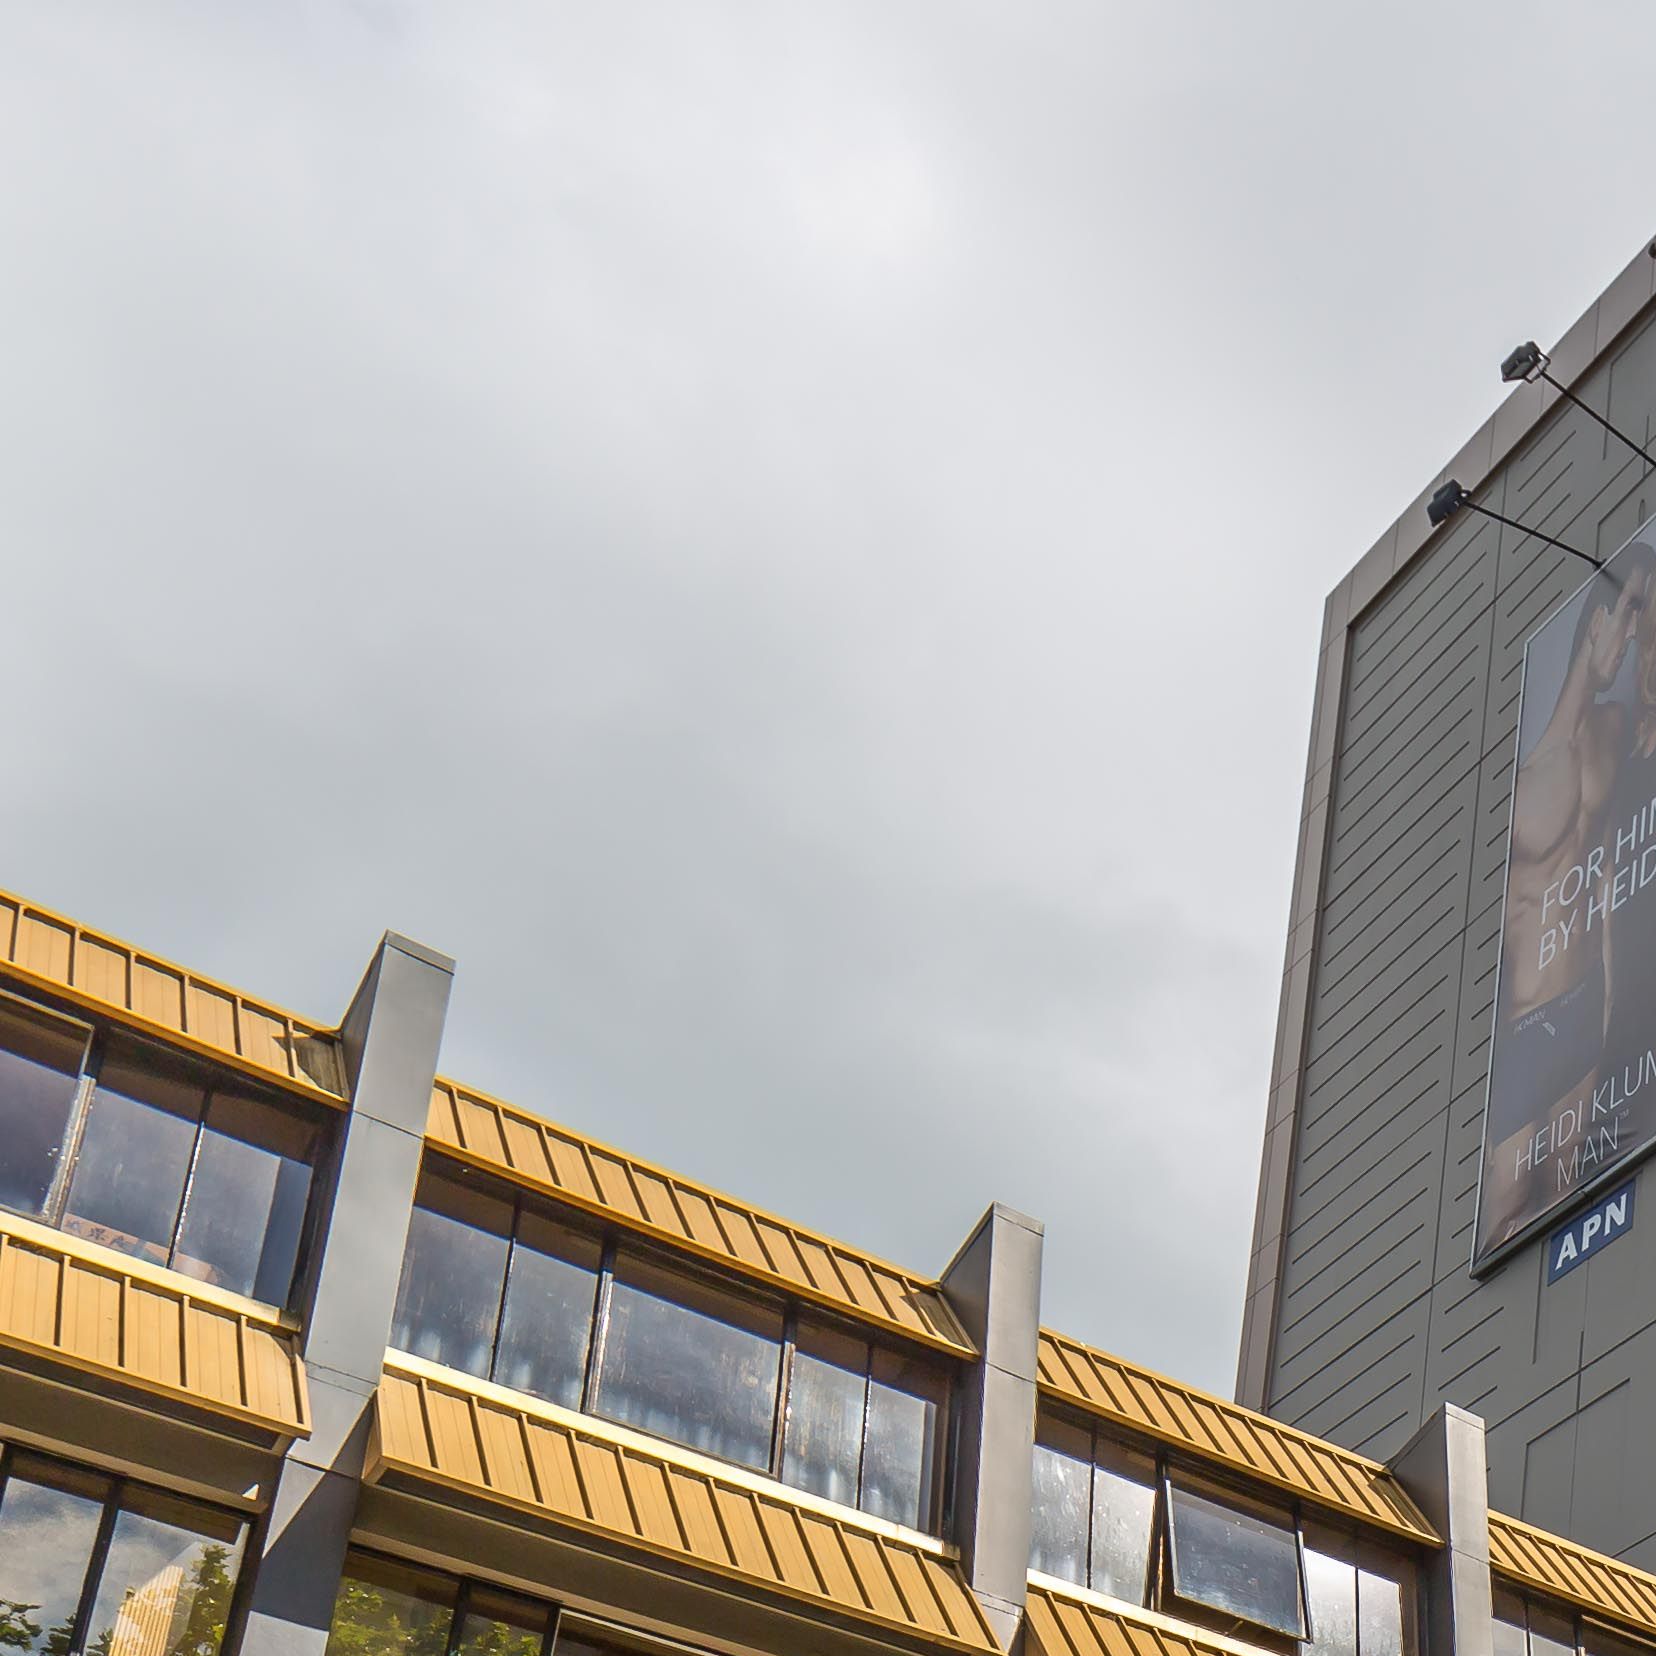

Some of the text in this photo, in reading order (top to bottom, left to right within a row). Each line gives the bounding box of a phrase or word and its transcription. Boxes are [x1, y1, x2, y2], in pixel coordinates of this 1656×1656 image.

[1541, 845, 1605, 925] FOR
[1538, 908, 1578, 971] BY
[1514, 1100, 1583, 1181] HEIDI
[1554, 1193, 1628, 1271] APN
